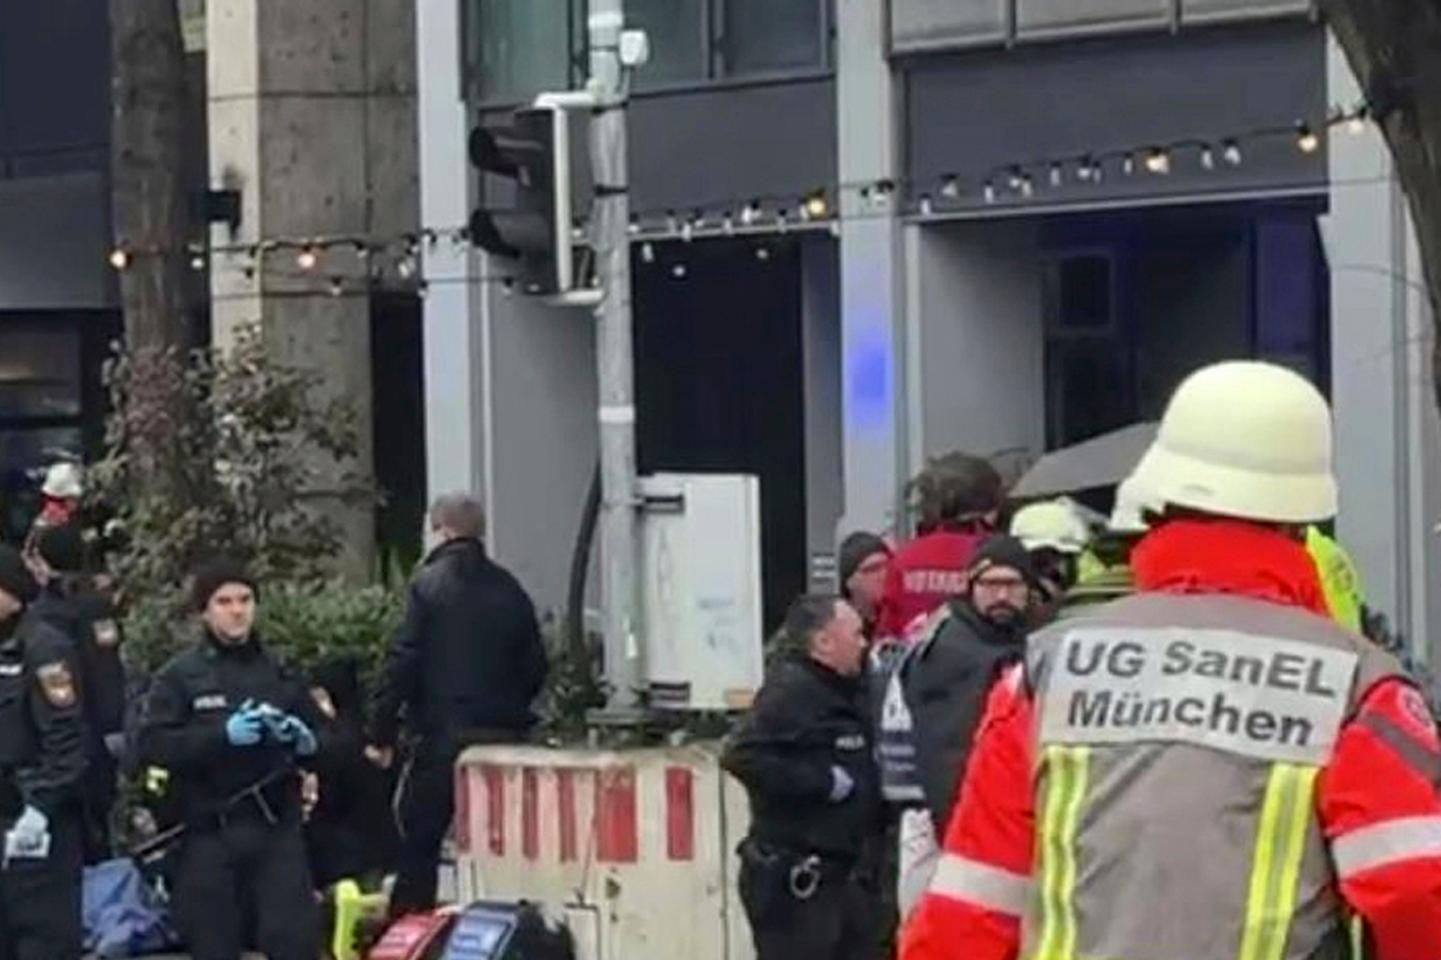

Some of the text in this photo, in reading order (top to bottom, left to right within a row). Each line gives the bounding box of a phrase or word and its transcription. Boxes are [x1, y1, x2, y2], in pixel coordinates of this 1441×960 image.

[1066, 640, 1337, 698] UG SanEL
[1067, 690, 1315, 747] München
